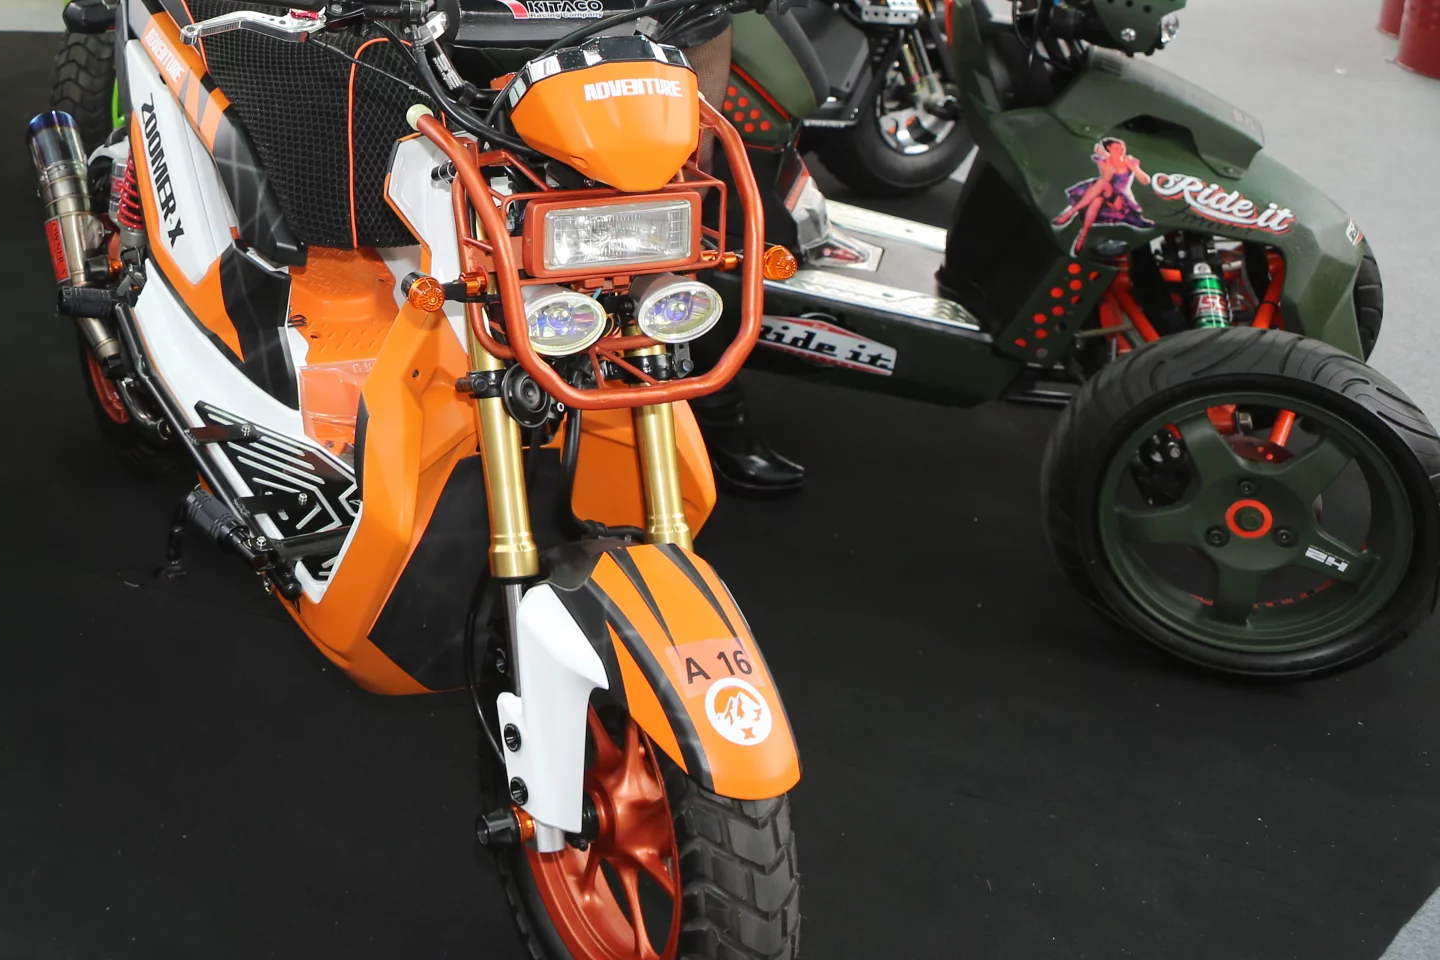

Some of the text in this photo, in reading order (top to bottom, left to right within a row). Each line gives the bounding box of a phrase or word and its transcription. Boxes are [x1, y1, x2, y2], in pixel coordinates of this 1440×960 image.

[526, 0, 604, 13] KITACO
[530, 11, 604, 20] Racing Company
[144, 27, 185, 84] ADVENTURE
[584, 78, 684, 101] ADVENTURE
[141, 92, 185, 250] ZOOMER-X
[1151, 173, 1297, 234] Ride it
[759, 324, 837, 357] Ride
[845, 343, 895, 371] it
[685, 650, 753, 685] A 16
